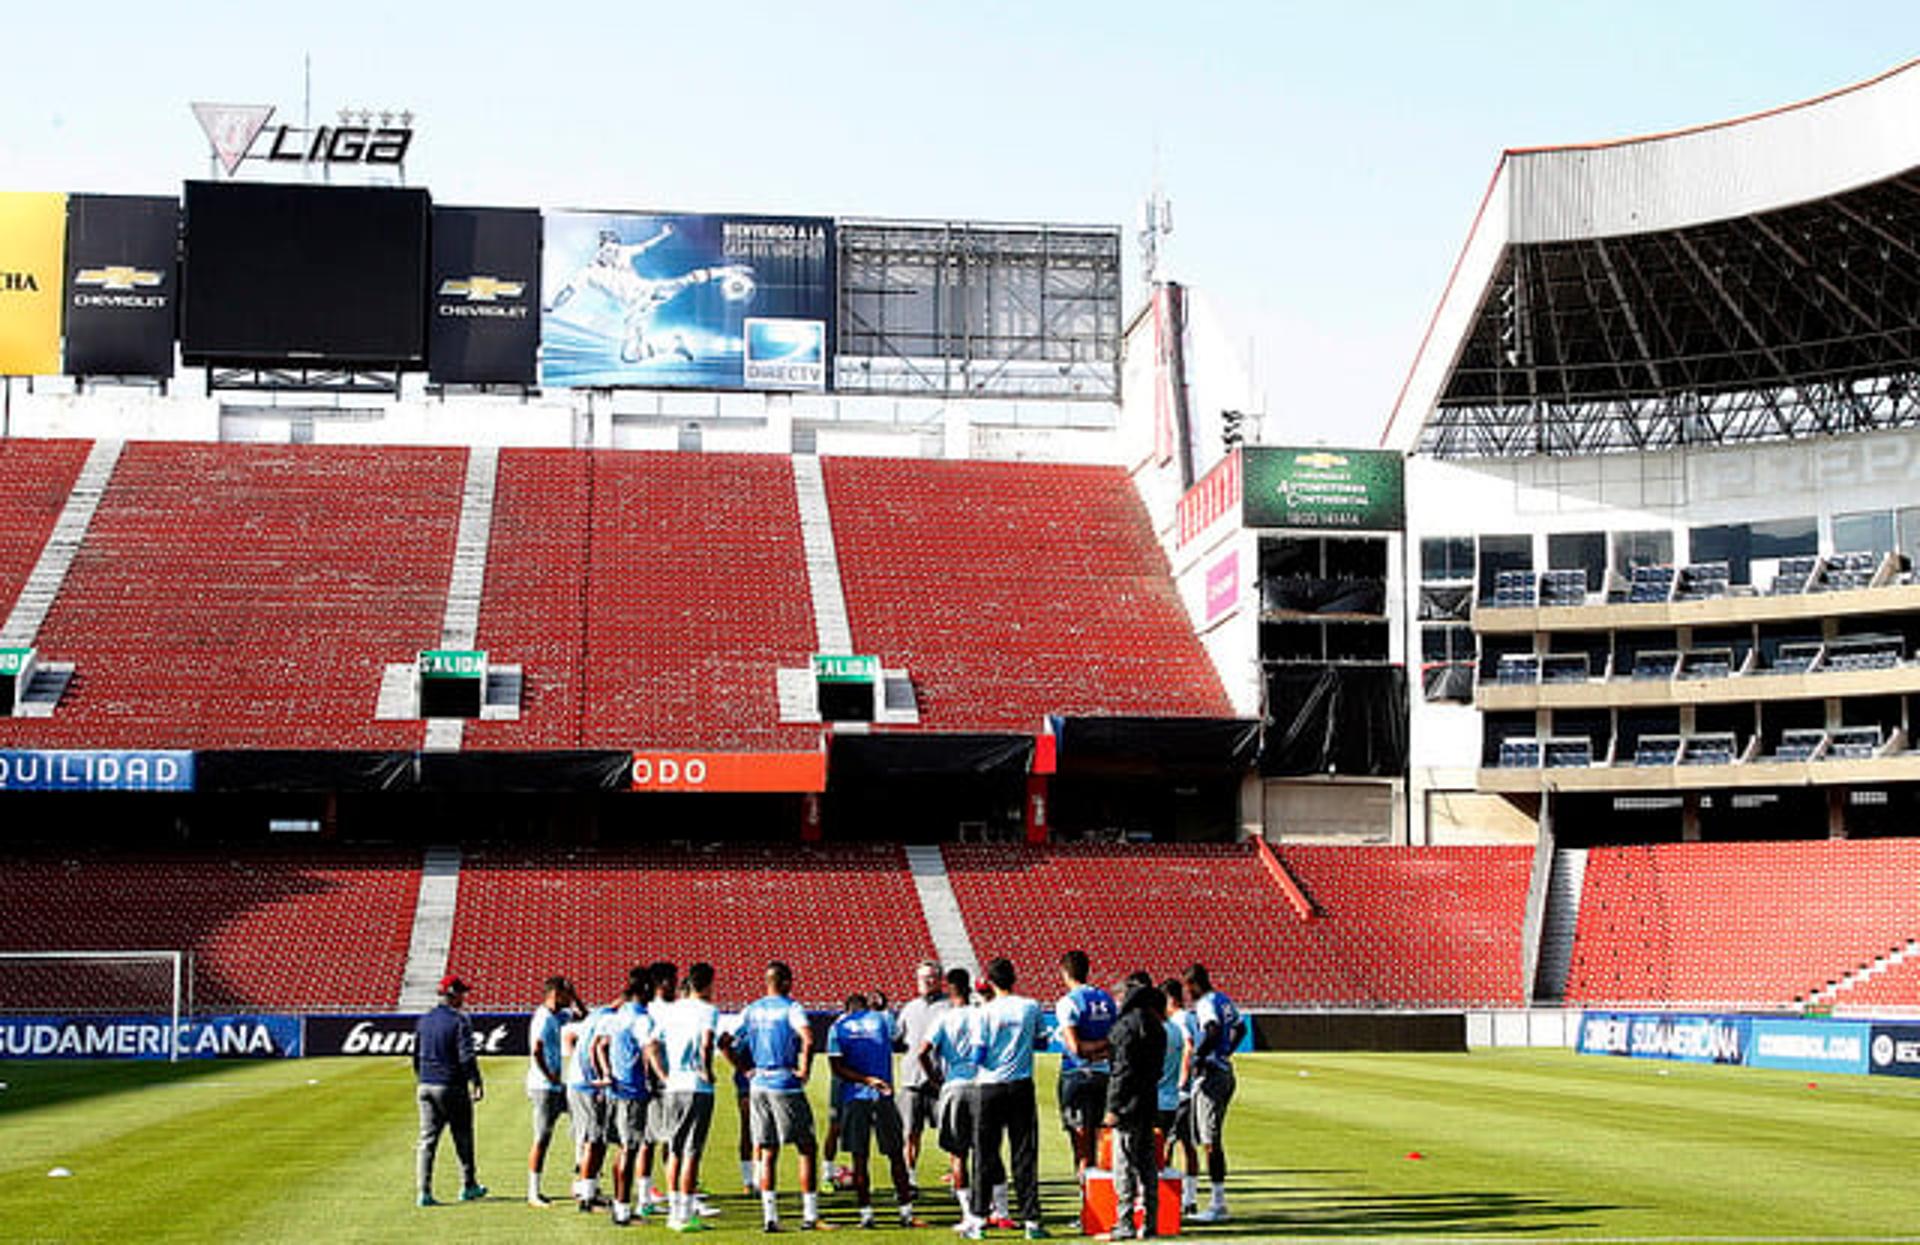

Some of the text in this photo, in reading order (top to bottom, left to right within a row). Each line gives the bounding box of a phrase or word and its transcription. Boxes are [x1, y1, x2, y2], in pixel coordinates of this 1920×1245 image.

[0, 272, 39, 291] HA
[74, 294, 167, 307] CHEVROLET
[439, 305, 527, 319] CHEVROLET
[747, 365, 821, 382] DIRECTV
[0, 1025, 273, 1054] UDAMERICANA
